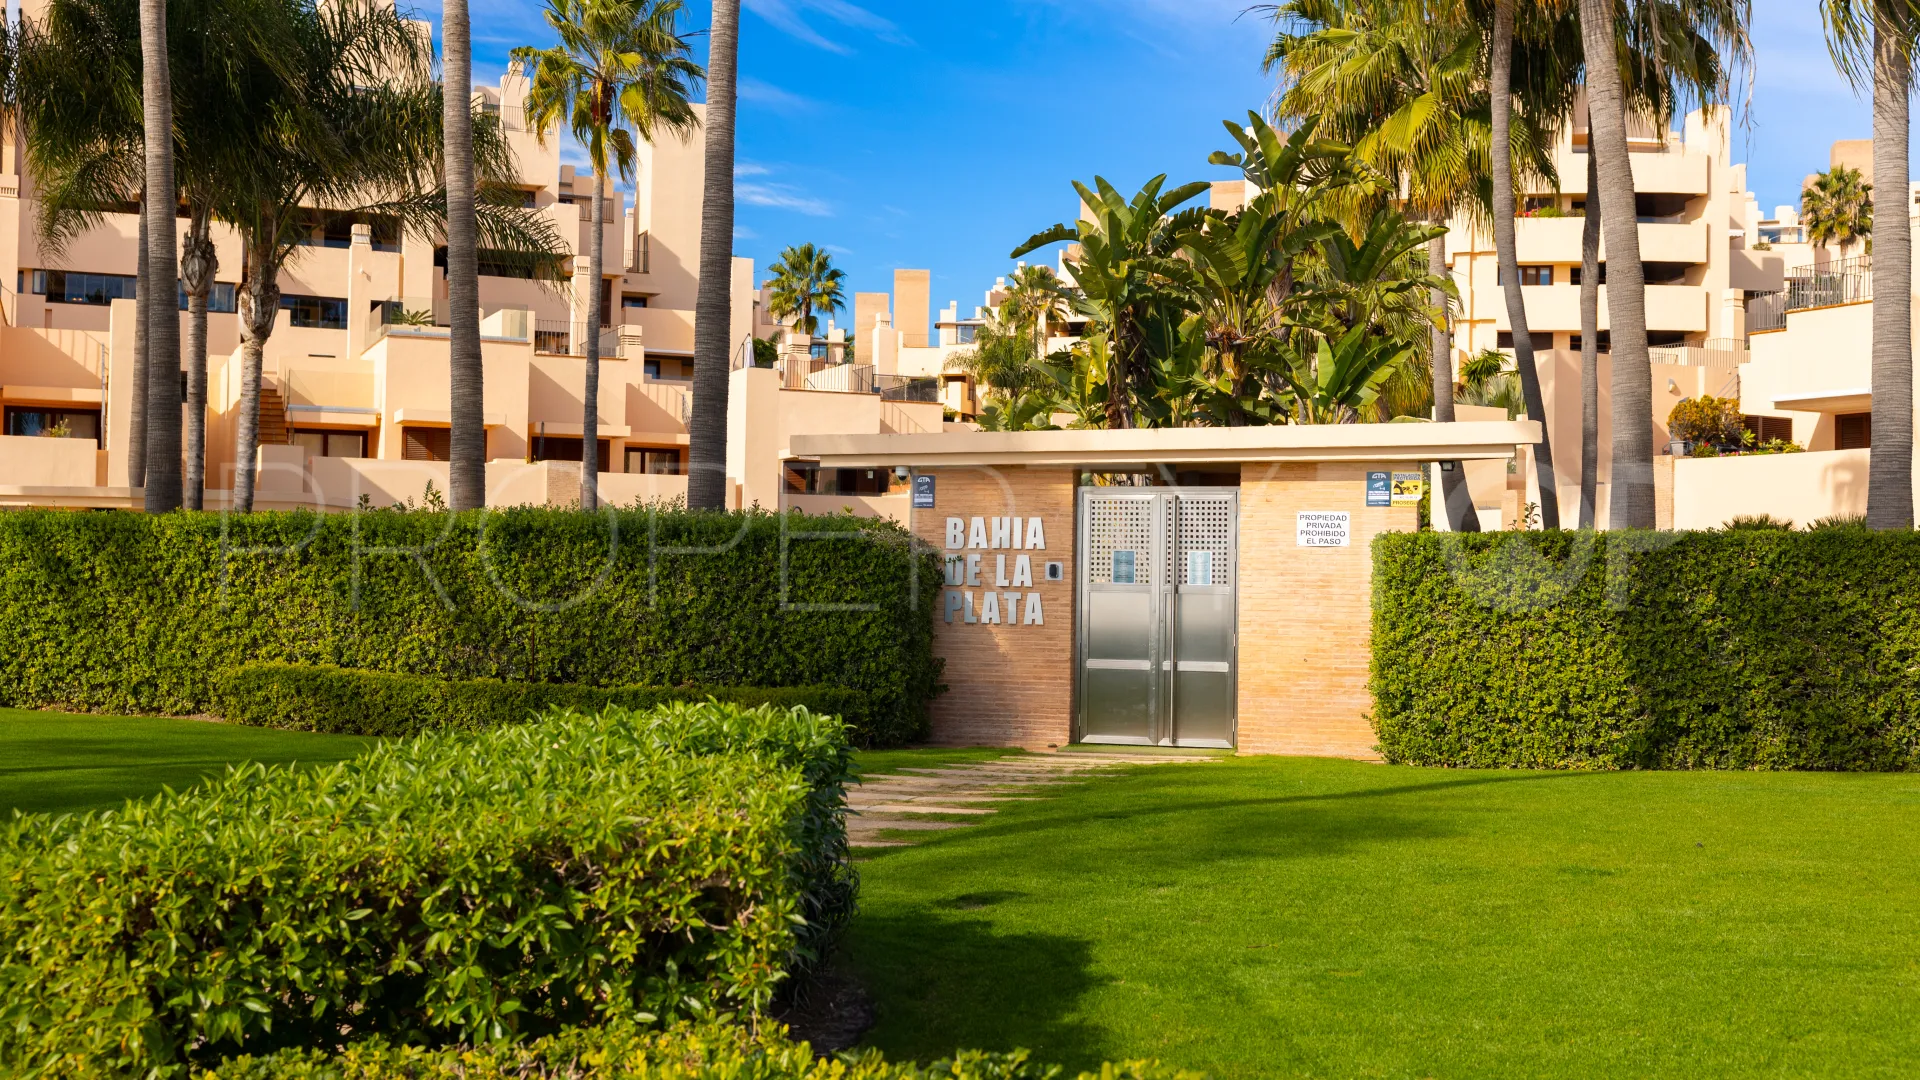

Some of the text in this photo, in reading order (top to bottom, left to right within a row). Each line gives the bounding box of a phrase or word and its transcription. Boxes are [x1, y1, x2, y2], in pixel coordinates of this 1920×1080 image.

[945, 516, 1046, 550] BAHIA
[945, 553, 1033, 588] DE LA
[944, 590, 1044, 626] PLATA
